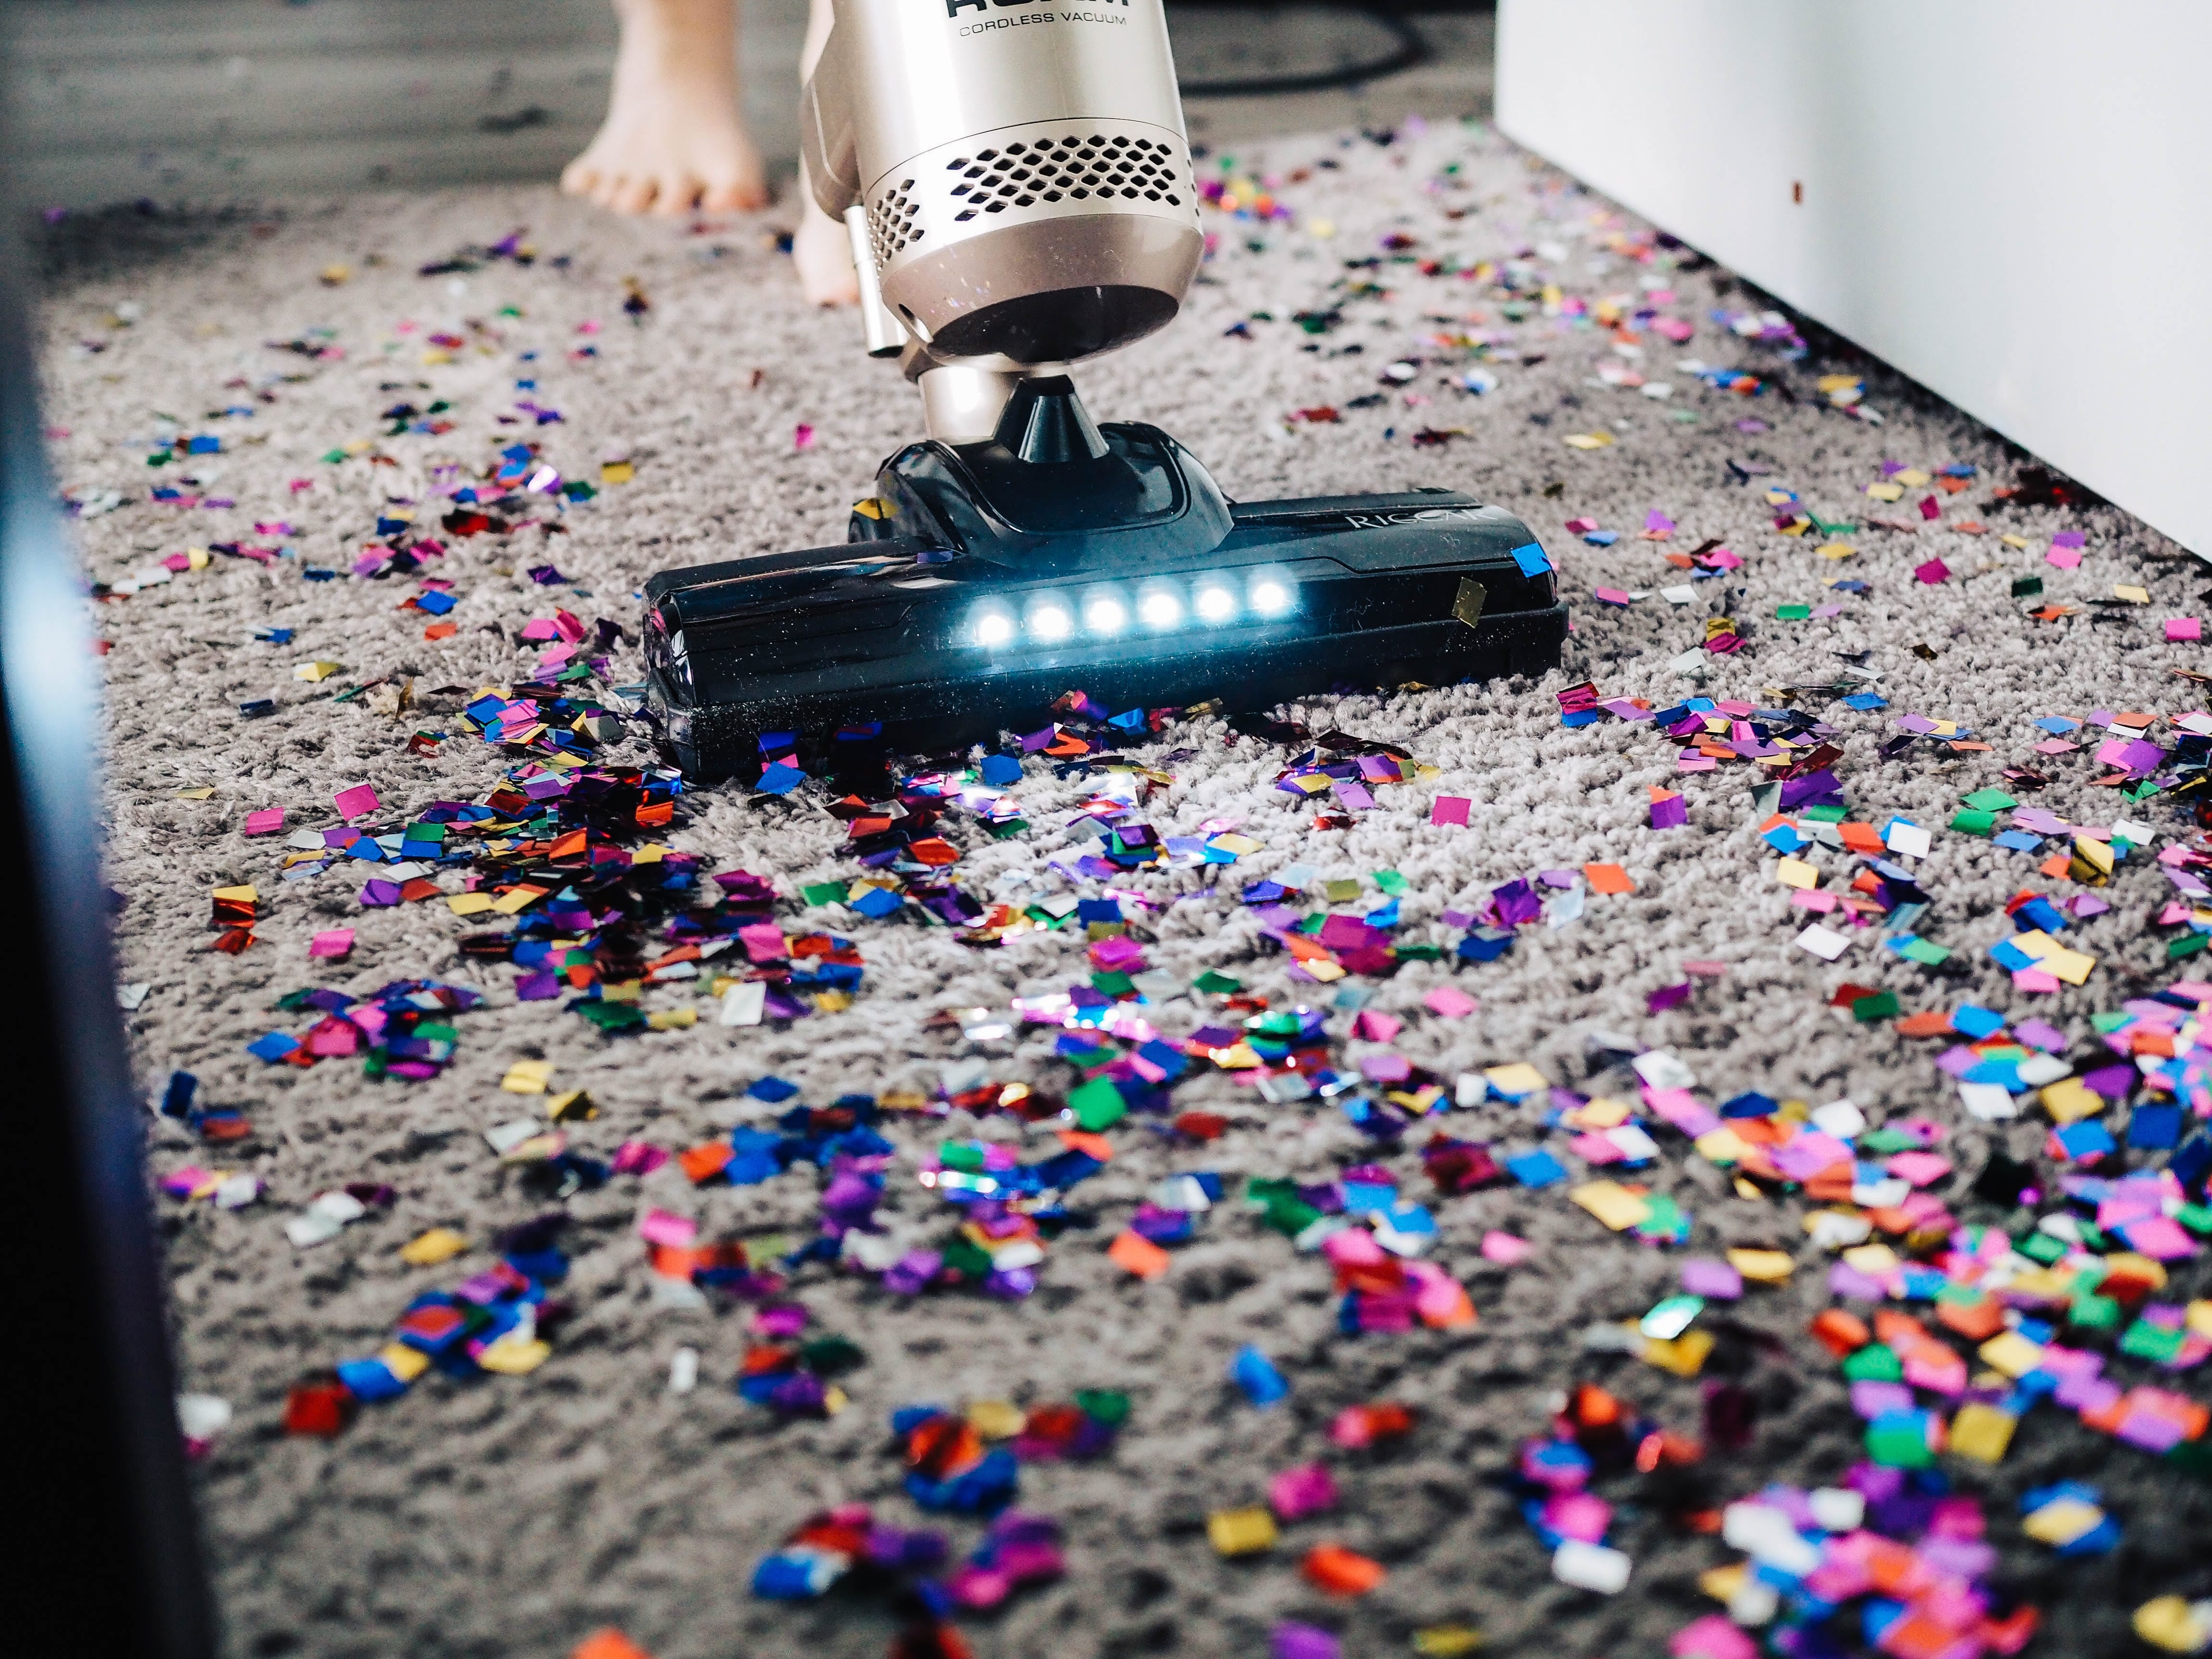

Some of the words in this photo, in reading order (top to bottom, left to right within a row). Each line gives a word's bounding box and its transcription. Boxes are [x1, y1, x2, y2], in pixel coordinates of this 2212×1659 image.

[960, 13, 1055, 36] CORDLESS
[1061, 12, 1127, 25] VACUUM
[1345, 509, 1498, 529] RICCAR
